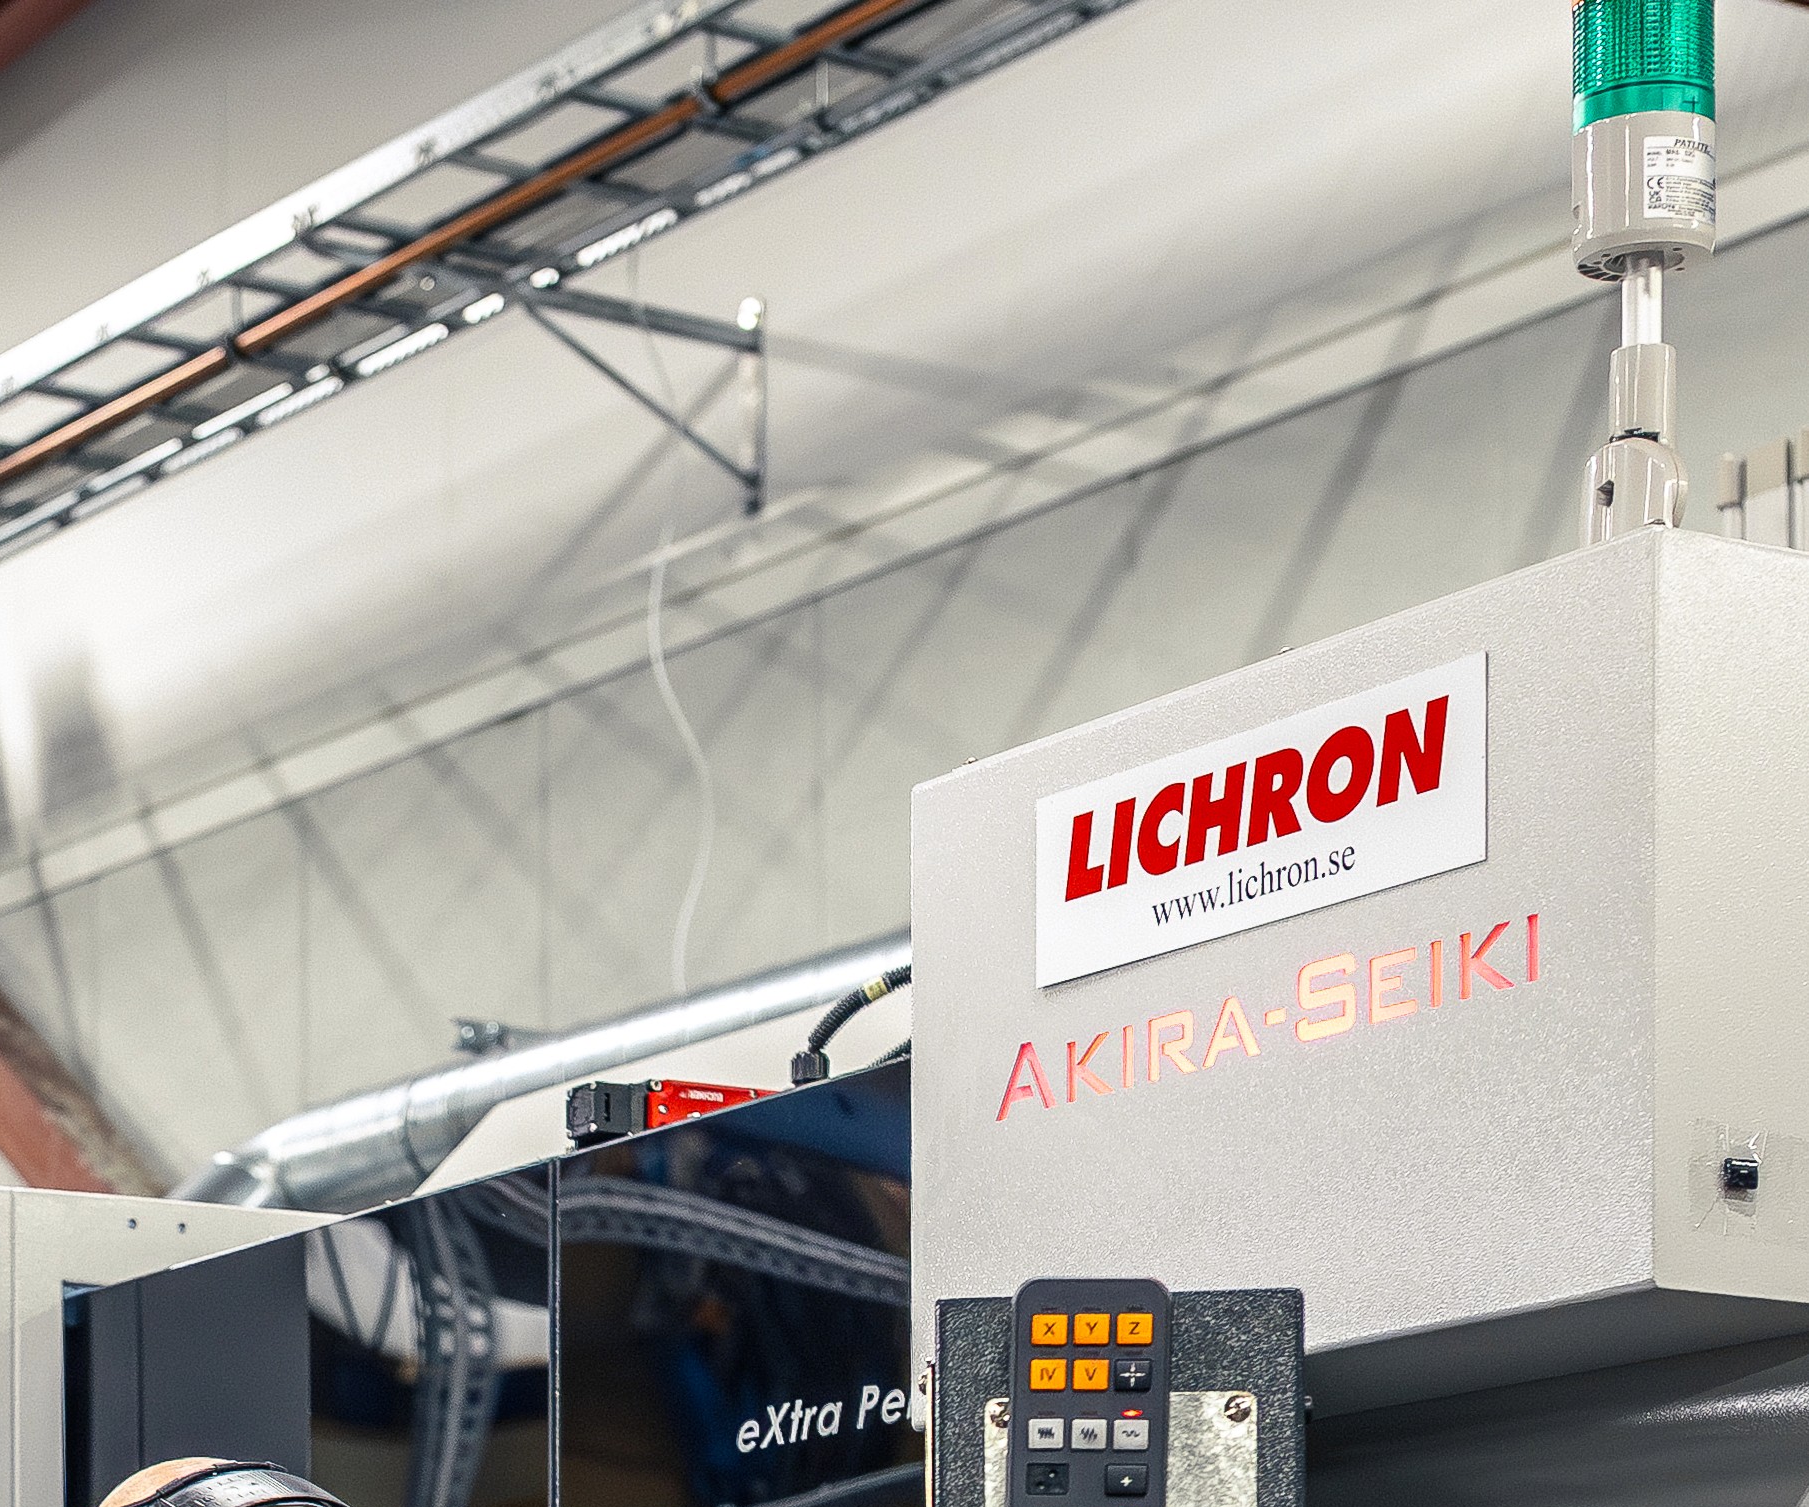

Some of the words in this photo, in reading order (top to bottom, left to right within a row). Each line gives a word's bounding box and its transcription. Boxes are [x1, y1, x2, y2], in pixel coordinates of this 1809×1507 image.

[1064, 694, 1450, 903] LICHRON
[1151, 842, 1357, 929] www.lichron.se
[995, 913, 1541, 1122] AKIRA-SEIKI
[1043, 1322, 1055, 1336] X
[1085, 1321, 1099, 1335] Y
[1128, 1321, 1141, 1335] Z
[1083, 1367, 1098, 1381] V
[736, 1397, 842, 1454] eXtra
